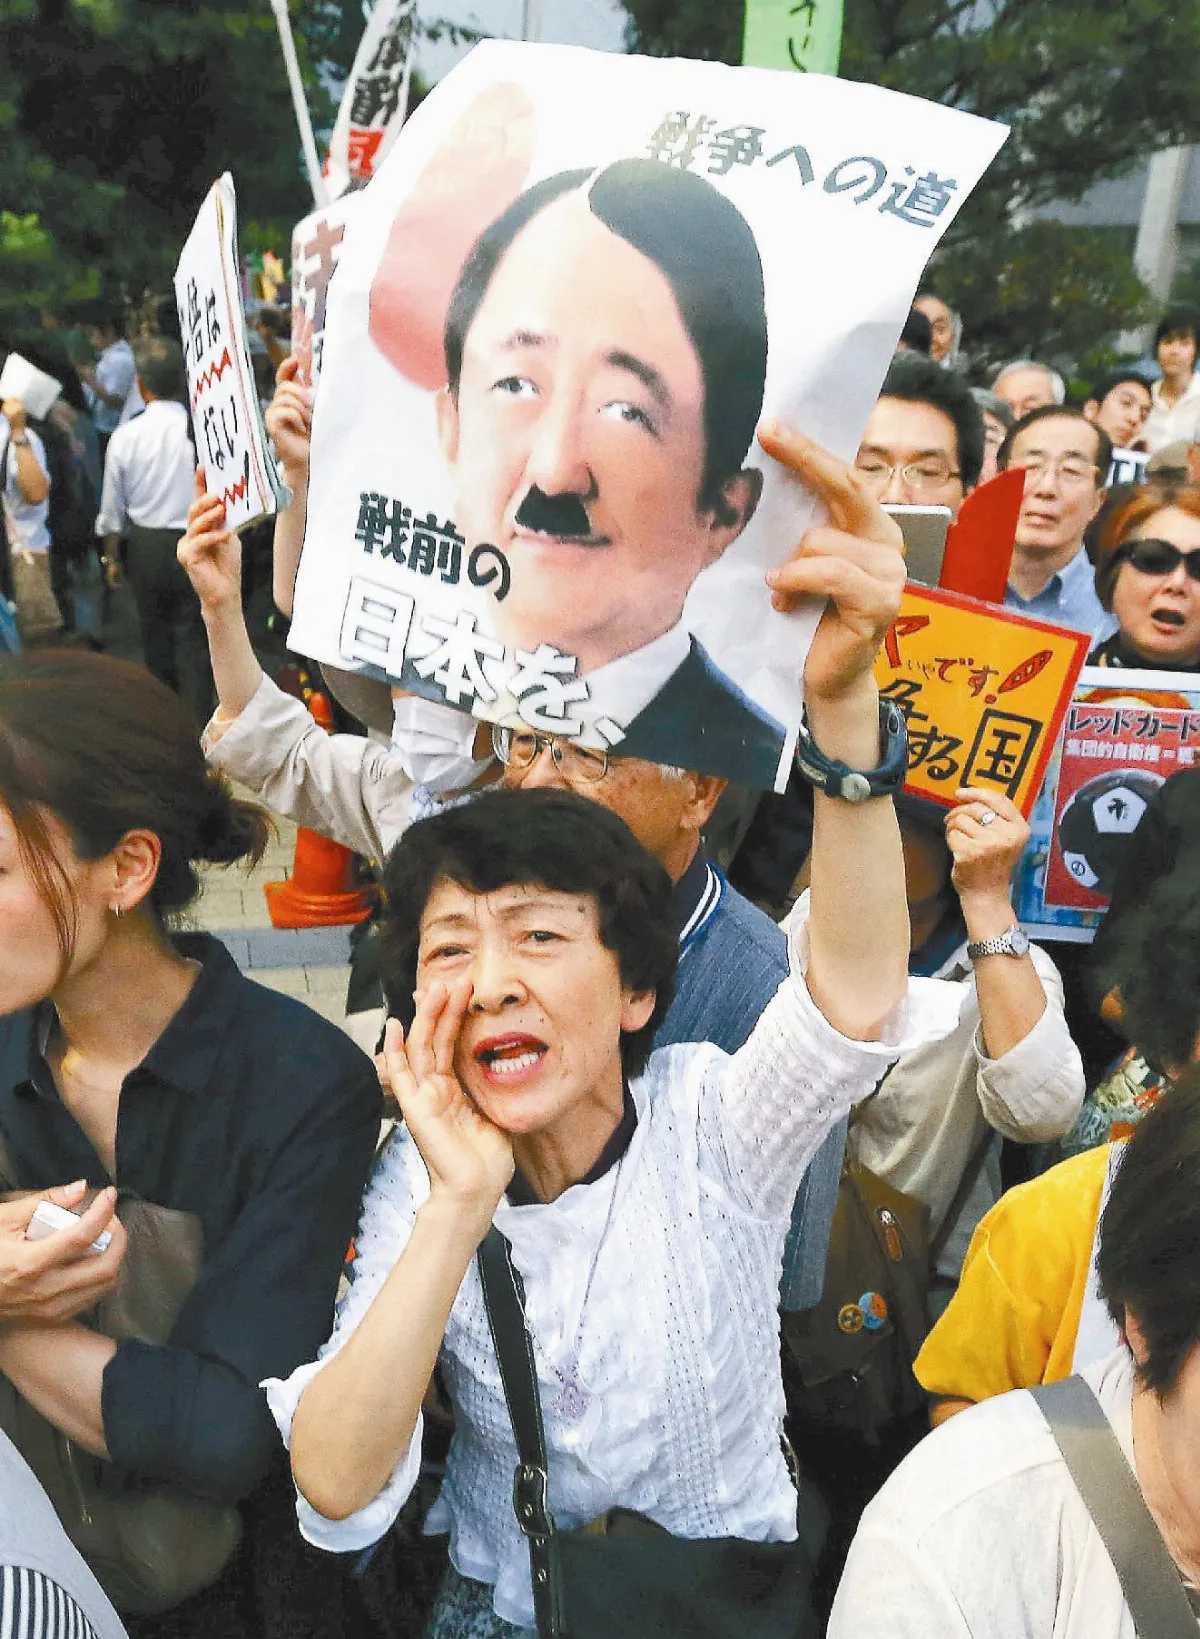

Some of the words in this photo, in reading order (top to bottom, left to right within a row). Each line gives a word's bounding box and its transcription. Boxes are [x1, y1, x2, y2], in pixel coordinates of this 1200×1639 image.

[646, 110, 958, 228] 戦争への道
[355, 490, 511, 602] 戦前の
